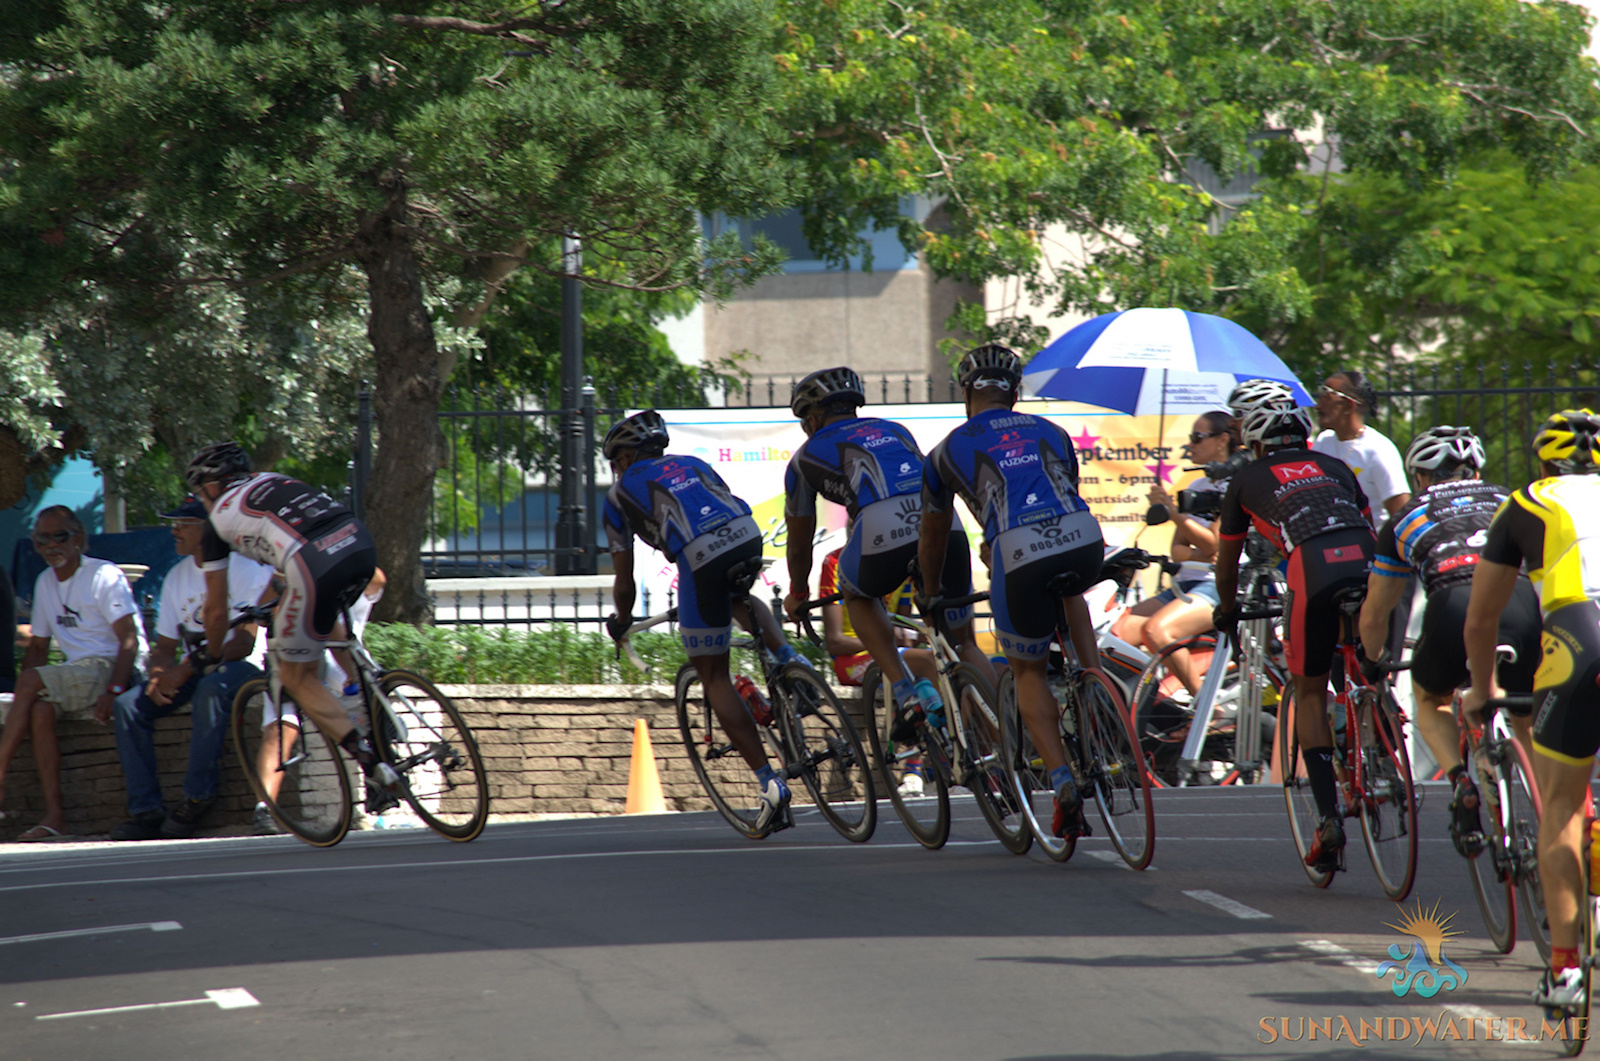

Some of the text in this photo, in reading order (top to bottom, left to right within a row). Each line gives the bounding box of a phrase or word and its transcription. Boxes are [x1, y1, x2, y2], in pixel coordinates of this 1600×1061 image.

[718, 447, 796, 462] Hamilto
[999, 454, 1038, 469] FUZION
[1074, 443, 1172, 465] eptember
[1085, 494, 1139, 504] outside
[1029, 529, 1082, 552] 800-8477
[281, 588, 303, 638] MIT
